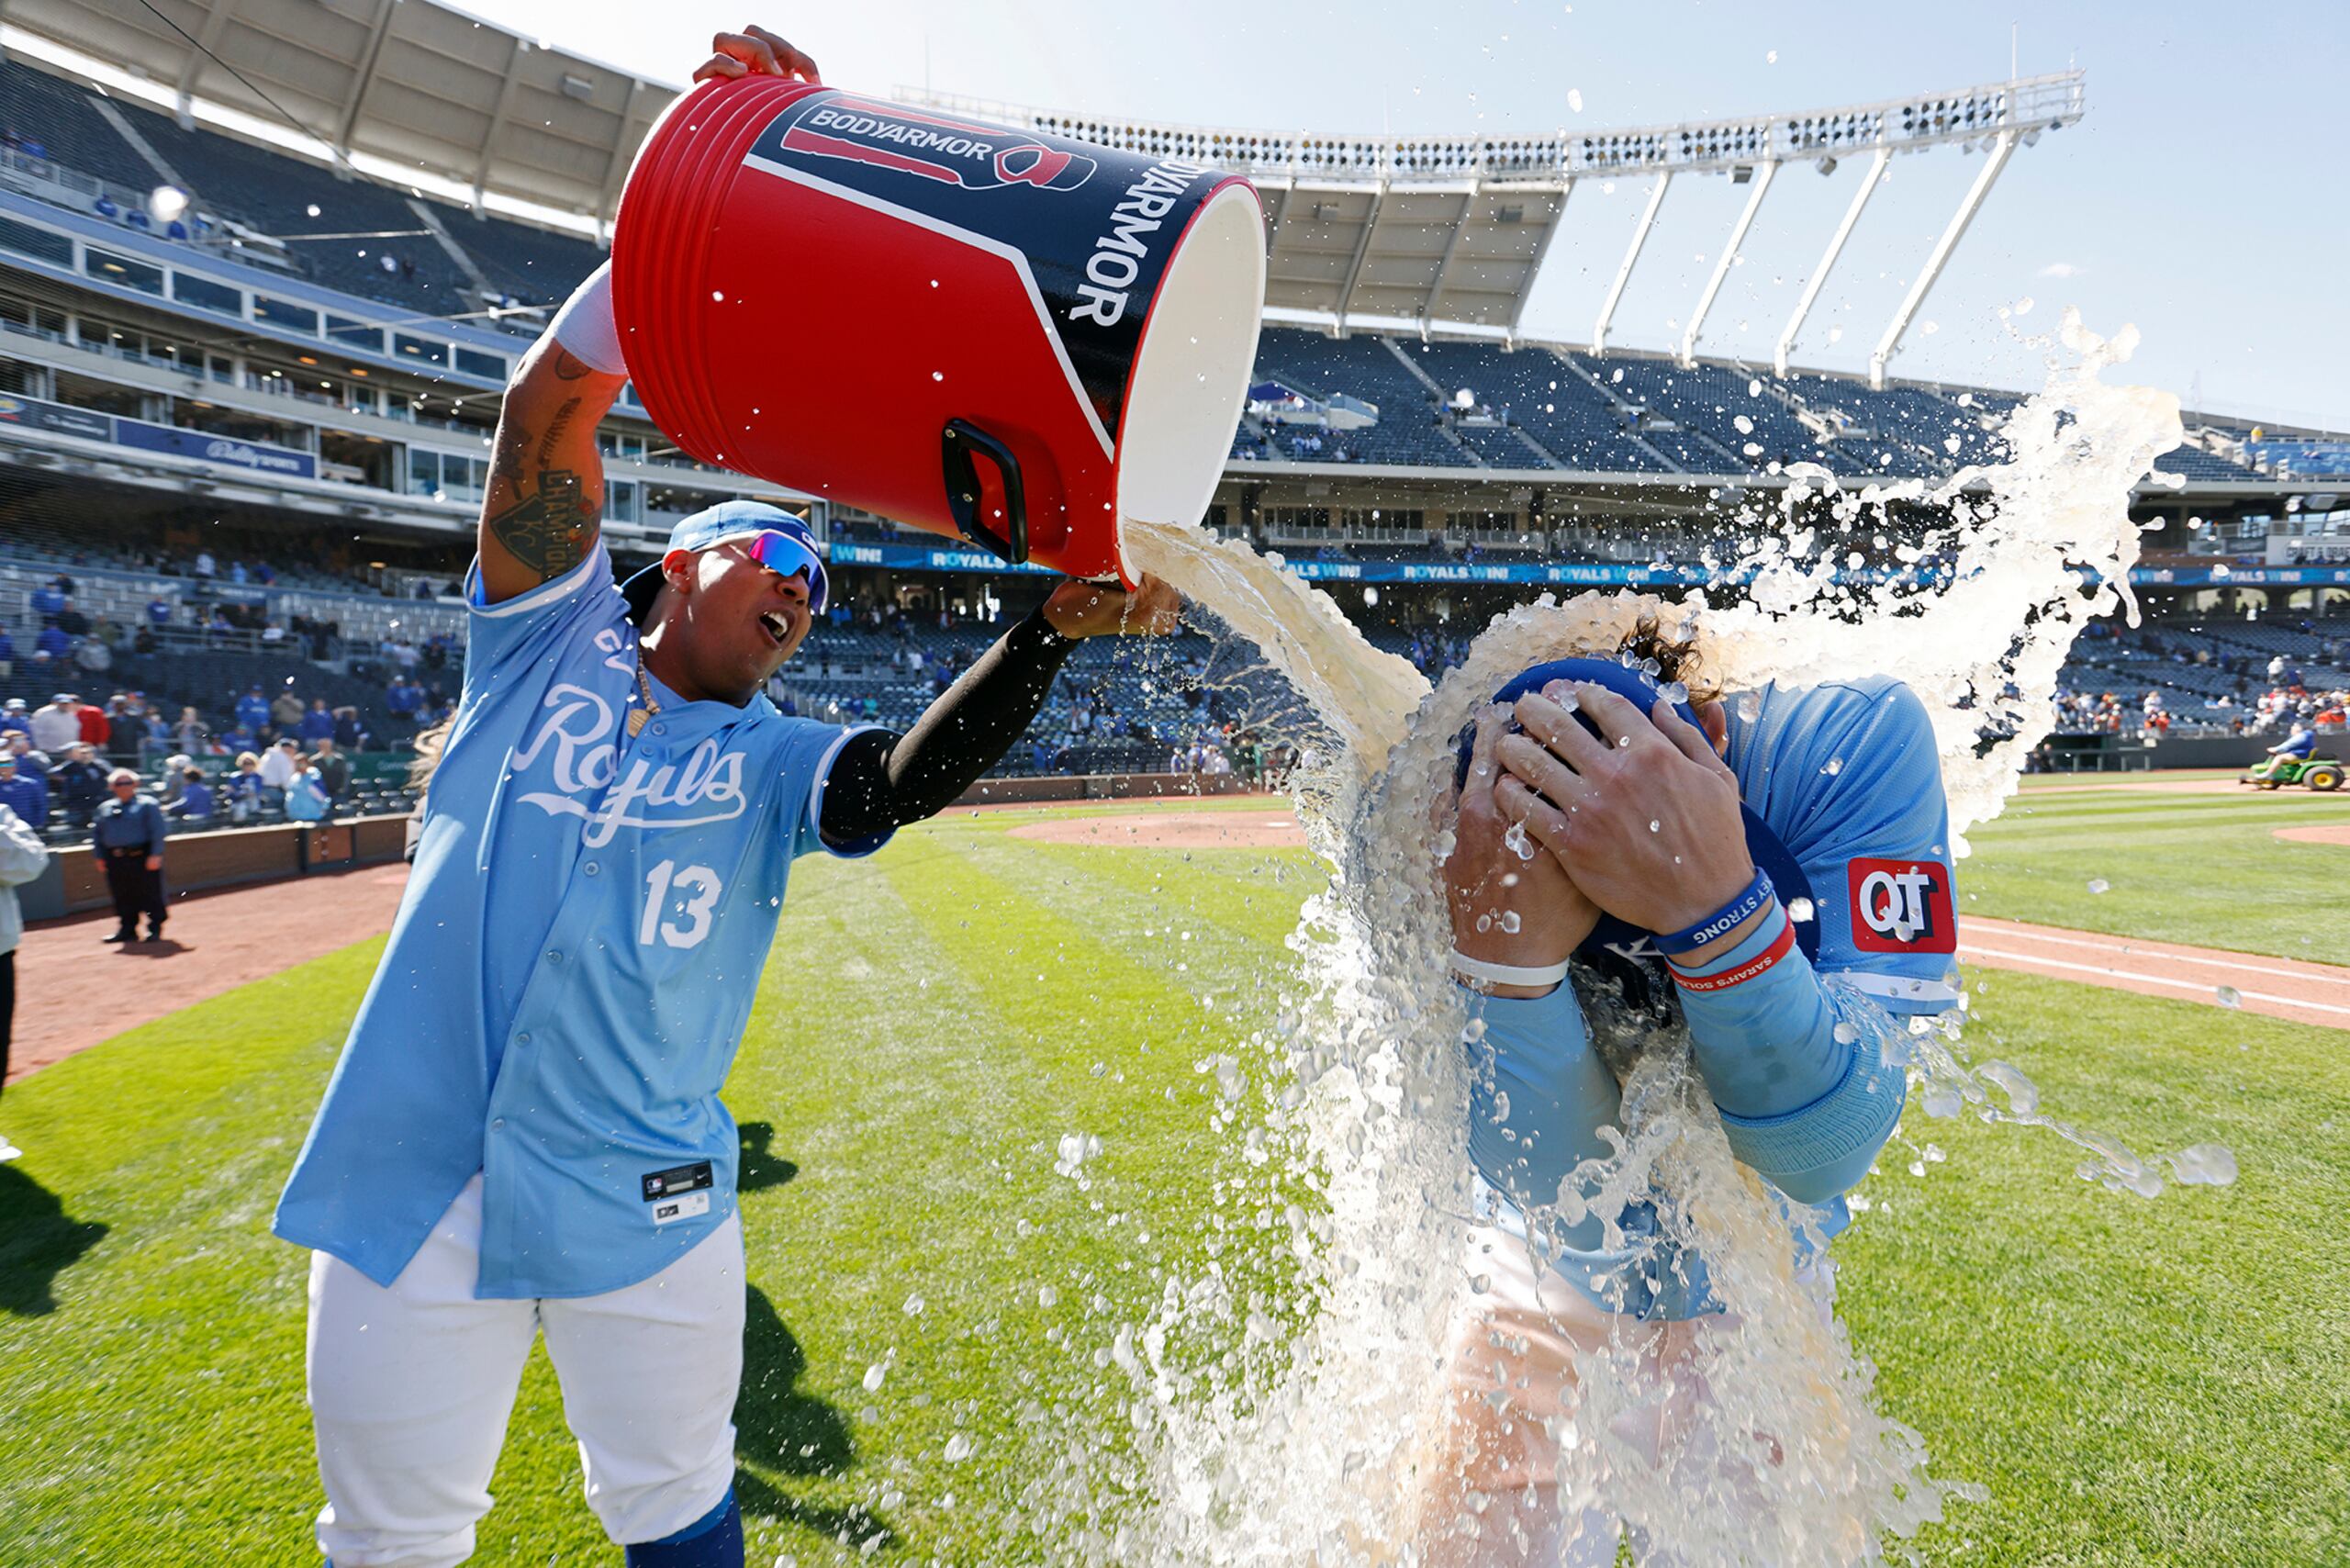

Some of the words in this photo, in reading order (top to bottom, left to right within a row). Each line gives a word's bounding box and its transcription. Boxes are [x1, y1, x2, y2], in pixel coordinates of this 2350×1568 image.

[809, 108, 994, 161] BODYARMOR
[1068, 160, 1214, 327] DYARMOR
[836, 545, 882, 563] WIN!
[932, 552, 1007, 569] ROYALS
[1322, 564, 1361, 578] WIN!
[1404, 566, 1469, 579] ROYALS
[1471, 566, 1509, 580] WIN!
[1548, 567, 1610, 581] ROYALS
[639, 858, 722, 949] 13
[1859, 870, 1930, 936] QT
[1692, 896, 1757, 944] STRONG
[1717, 956, 1773, 984] SARAH'S
